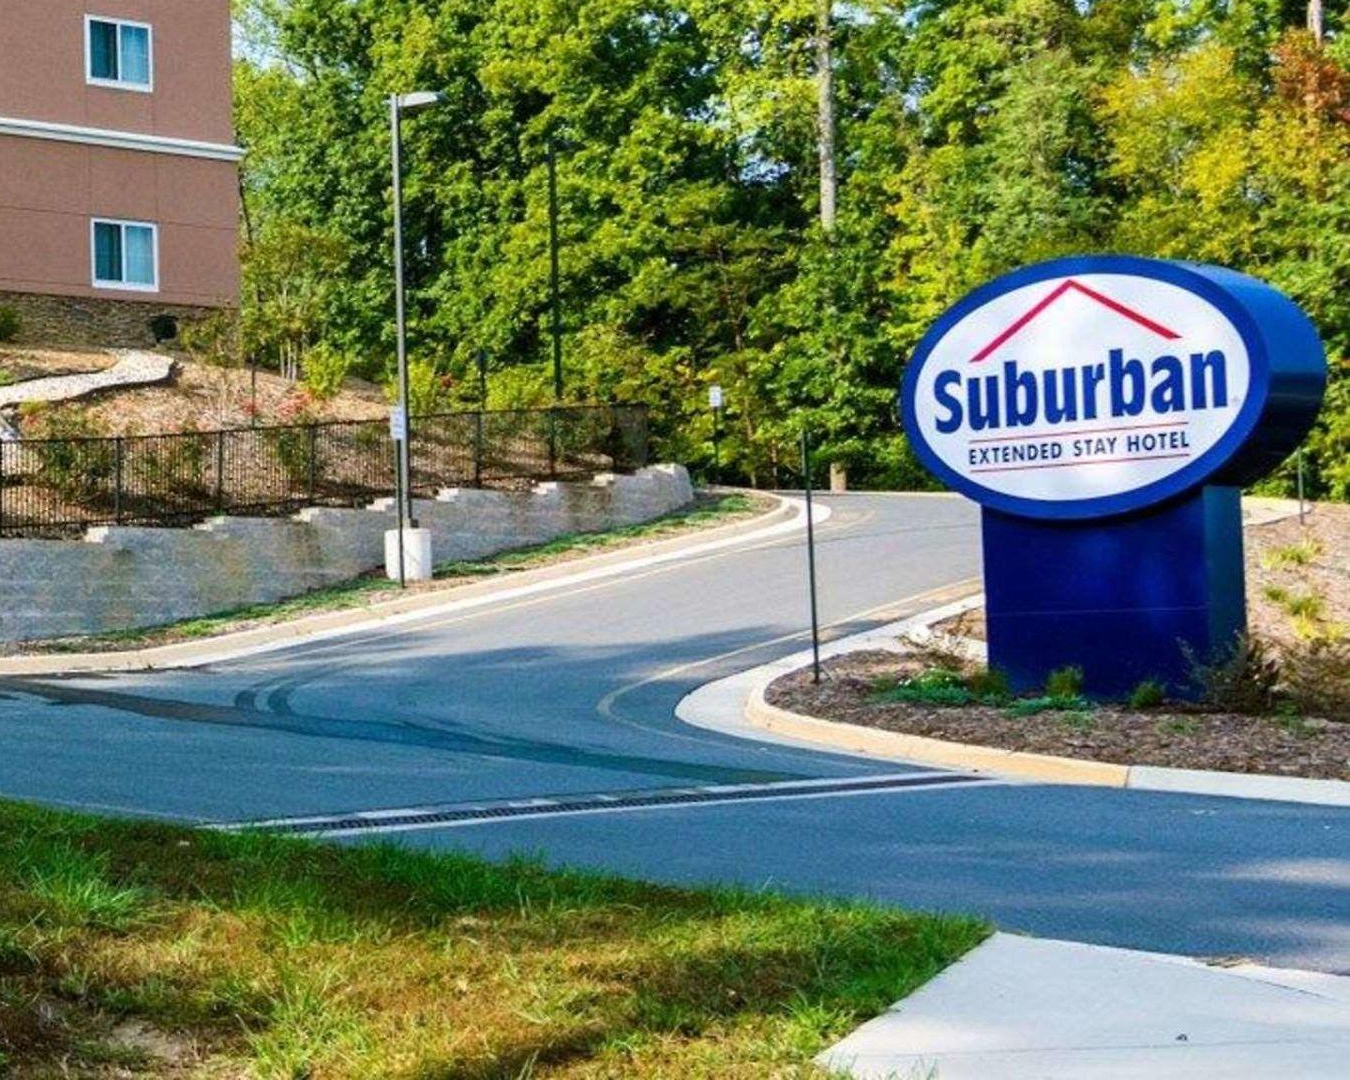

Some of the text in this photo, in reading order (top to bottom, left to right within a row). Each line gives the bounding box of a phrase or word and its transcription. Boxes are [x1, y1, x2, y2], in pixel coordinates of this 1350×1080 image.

[933, 348, 1228, 434] Suburban
[968, 431, 1190, 465] EXTENDED STAY HOTEL
